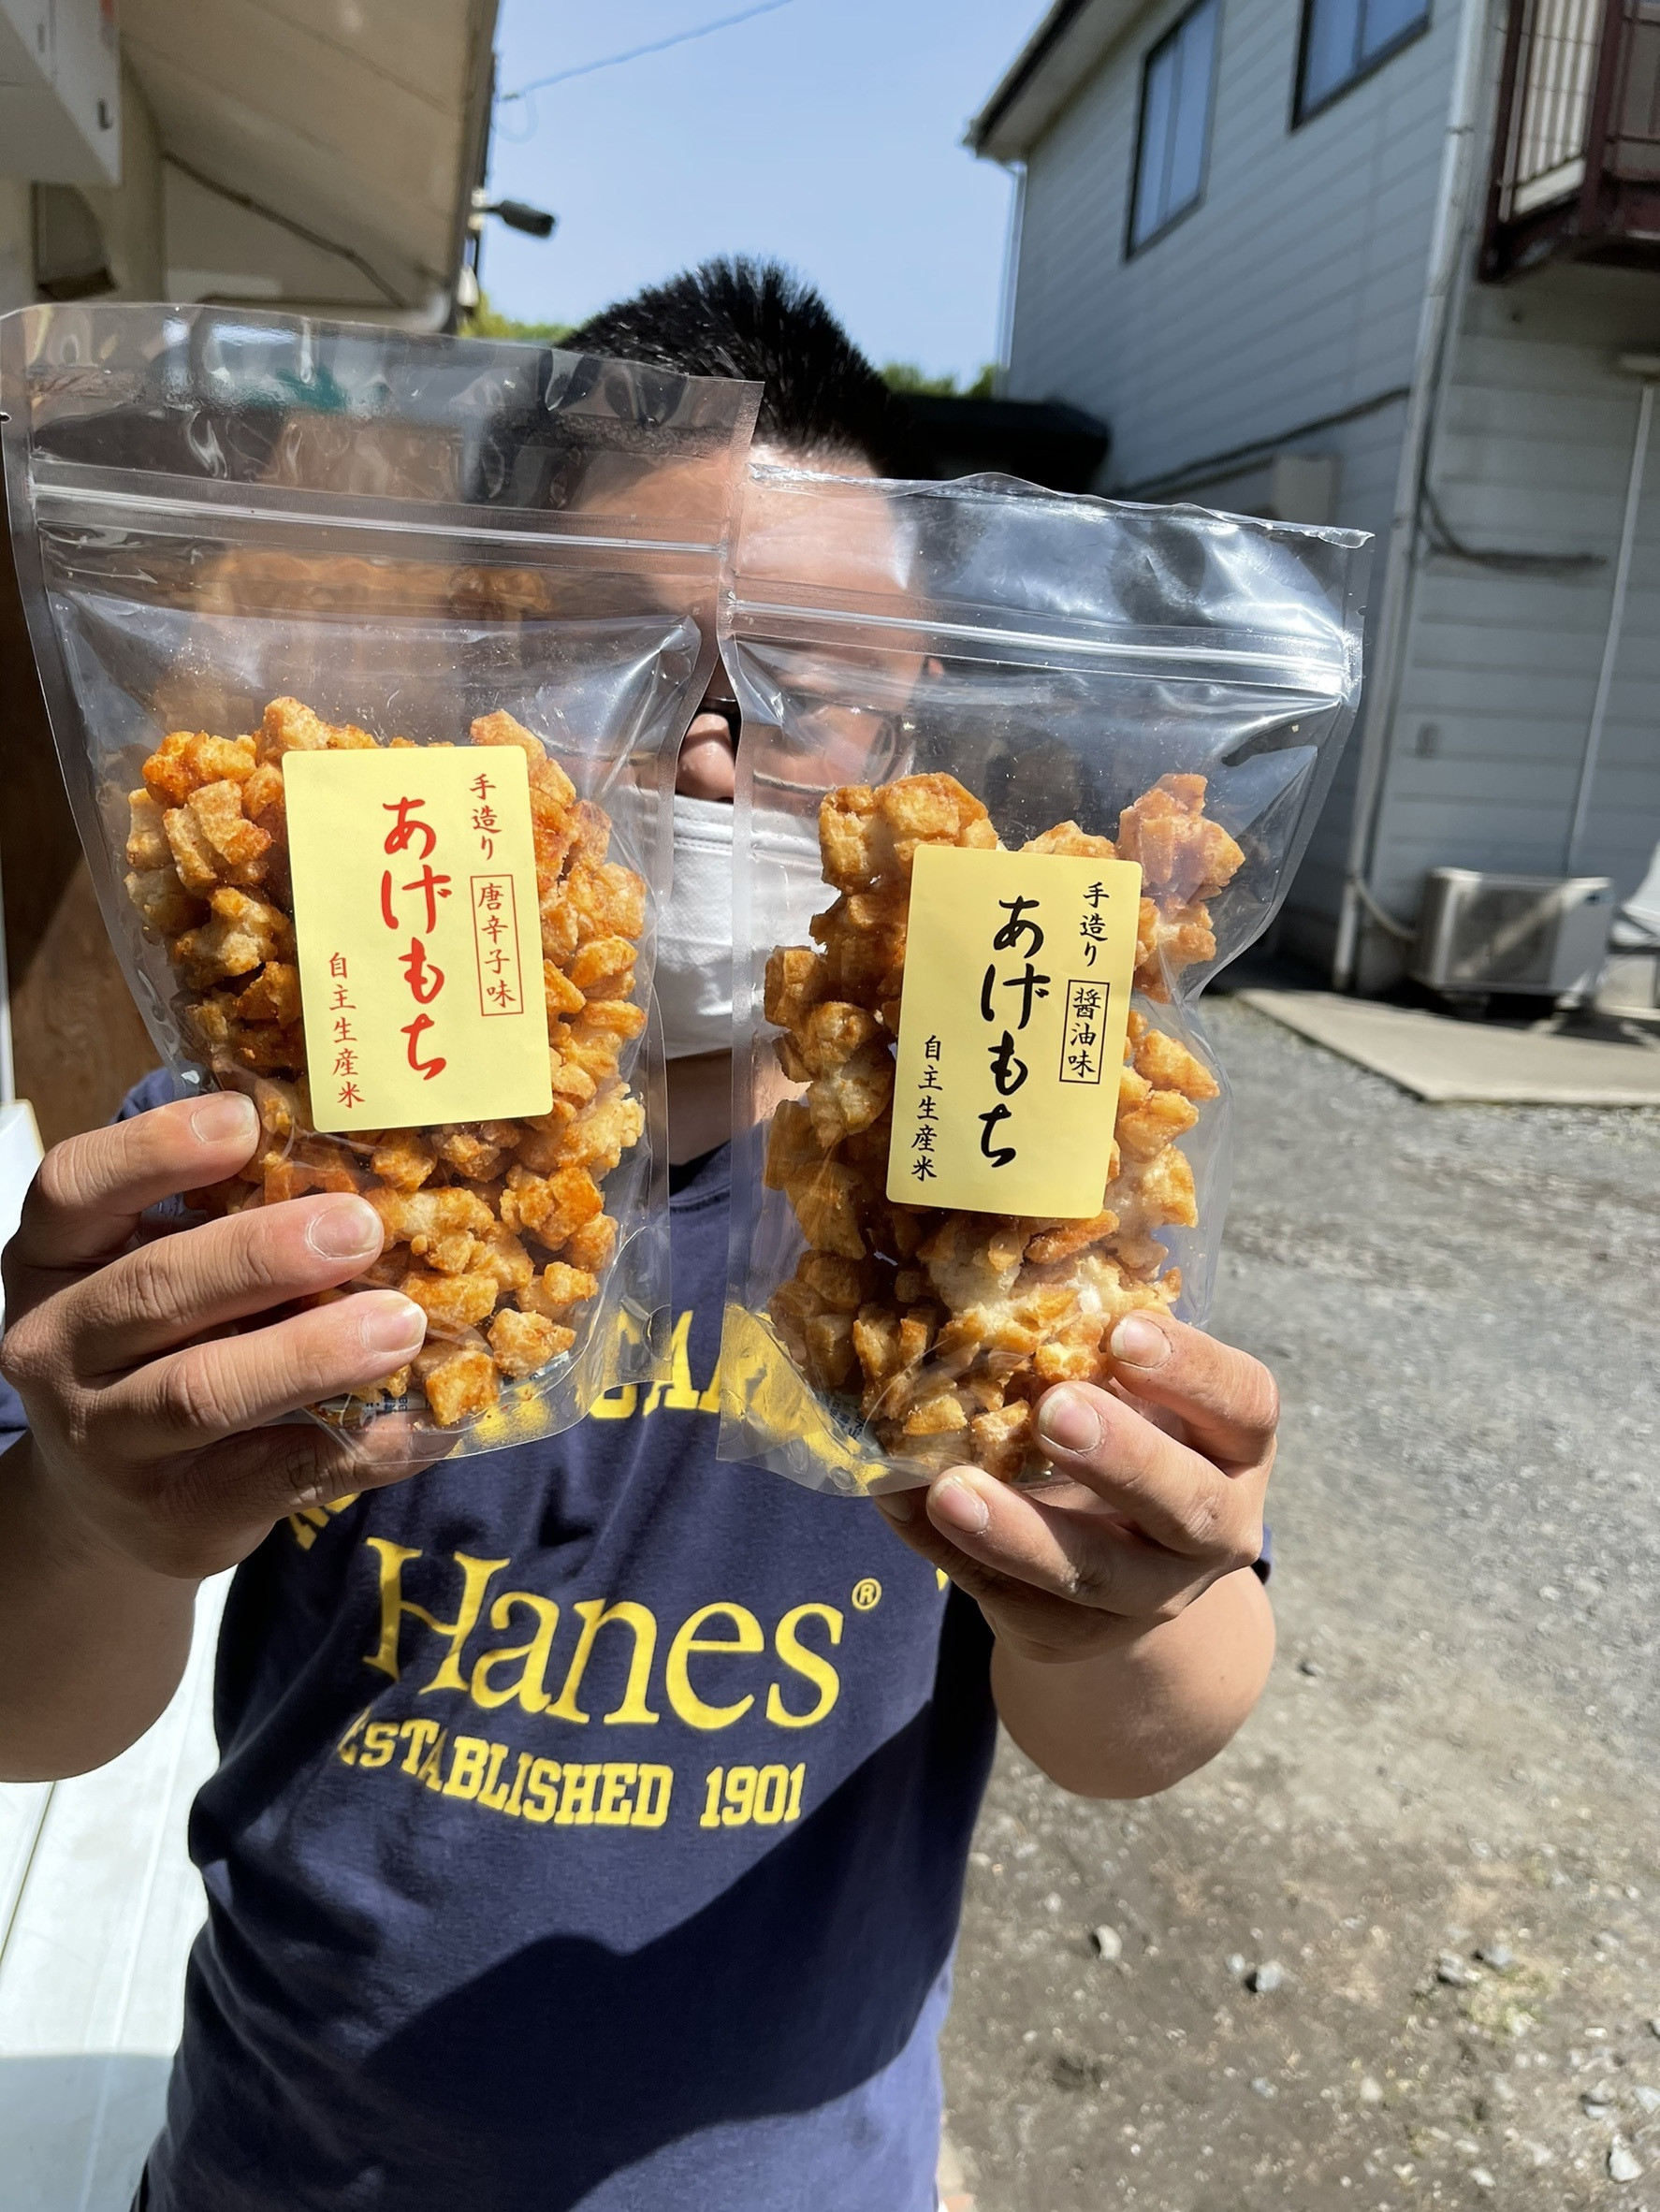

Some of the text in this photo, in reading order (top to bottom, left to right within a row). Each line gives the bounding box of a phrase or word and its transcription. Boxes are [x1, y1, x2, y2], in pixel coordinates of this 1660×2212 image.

[381, 796, 453, 1082] あげもち
[469, 773, 517, 1010] 手造り 唐辛子味
[1068, 881, 1110, 1079] 手造り 醤油味
[328, 952, 365, 1110] 自主生産米
[910, 1034, 943, 1183] 自主生産米
[978, 895, 1051, 1169] あげもち
[700, 1764, 805, 1828] 1901
